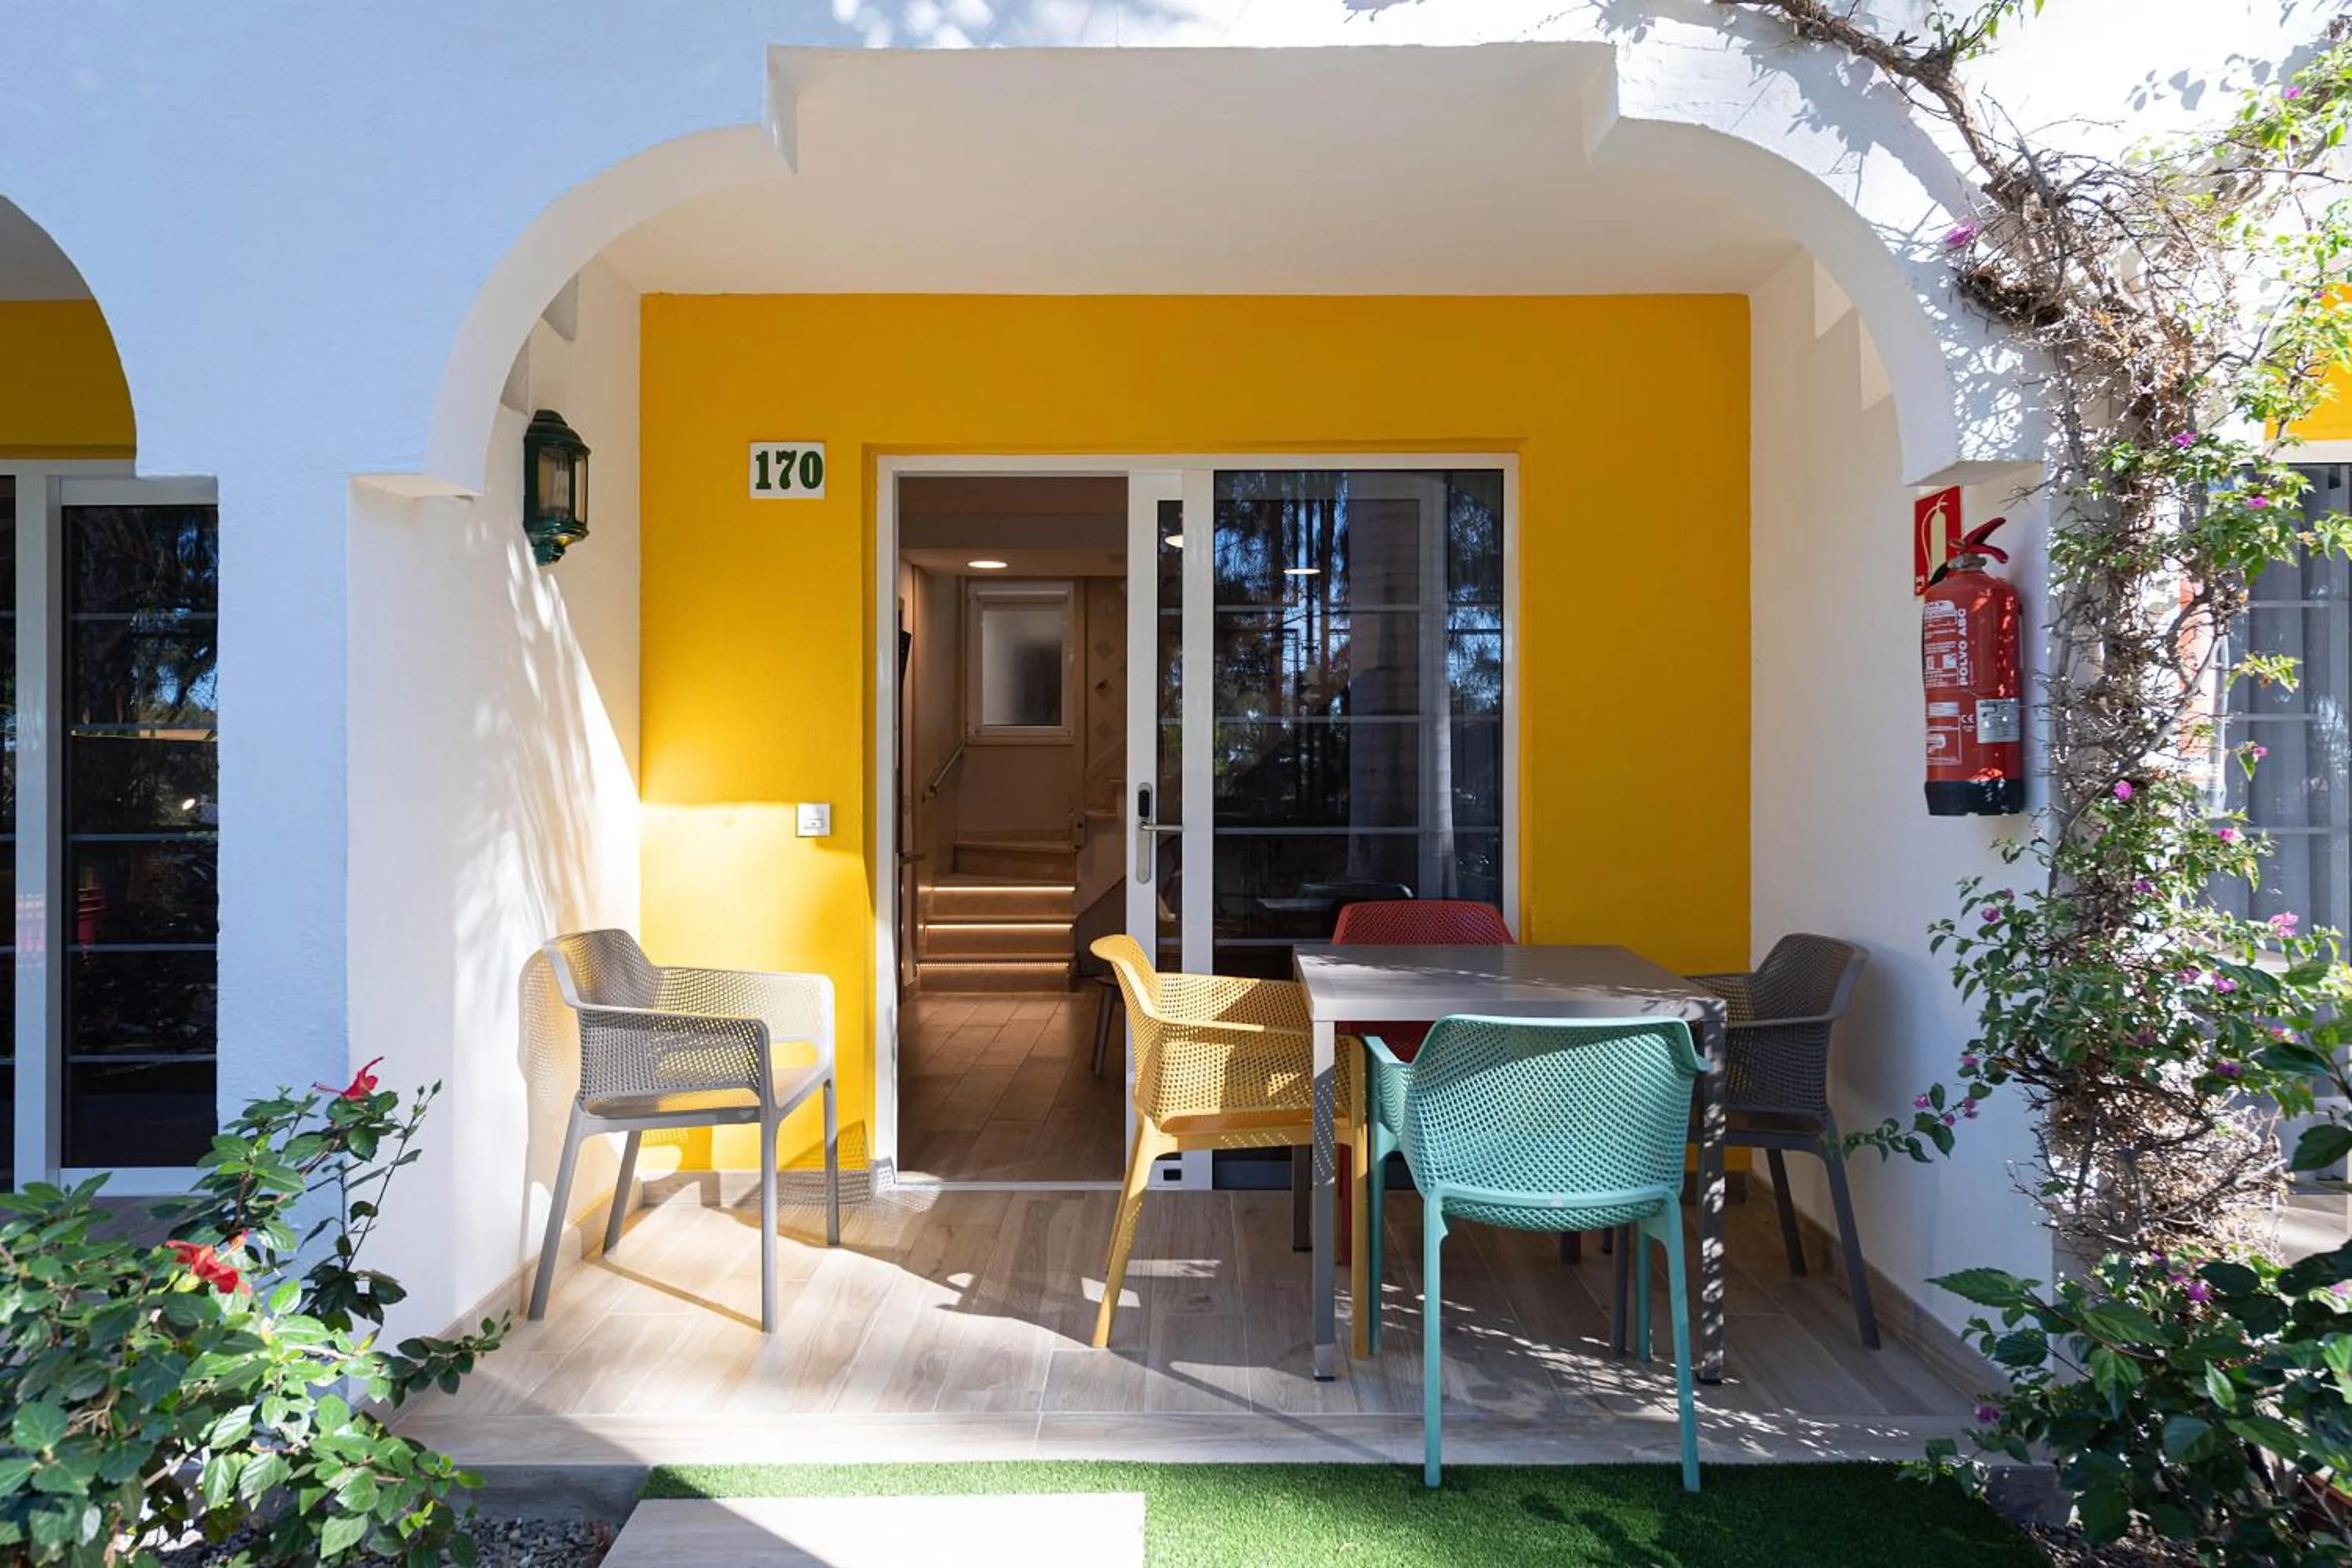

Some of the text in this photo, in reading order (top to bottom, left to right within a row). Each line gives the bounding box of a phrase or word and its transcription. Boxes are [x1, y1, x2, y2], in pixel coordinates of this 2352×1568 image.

[755, 450, 824, 490] 170
[1958, 642, 1969, 686] POLVO
[1961, 715, 1975, 724] CE
